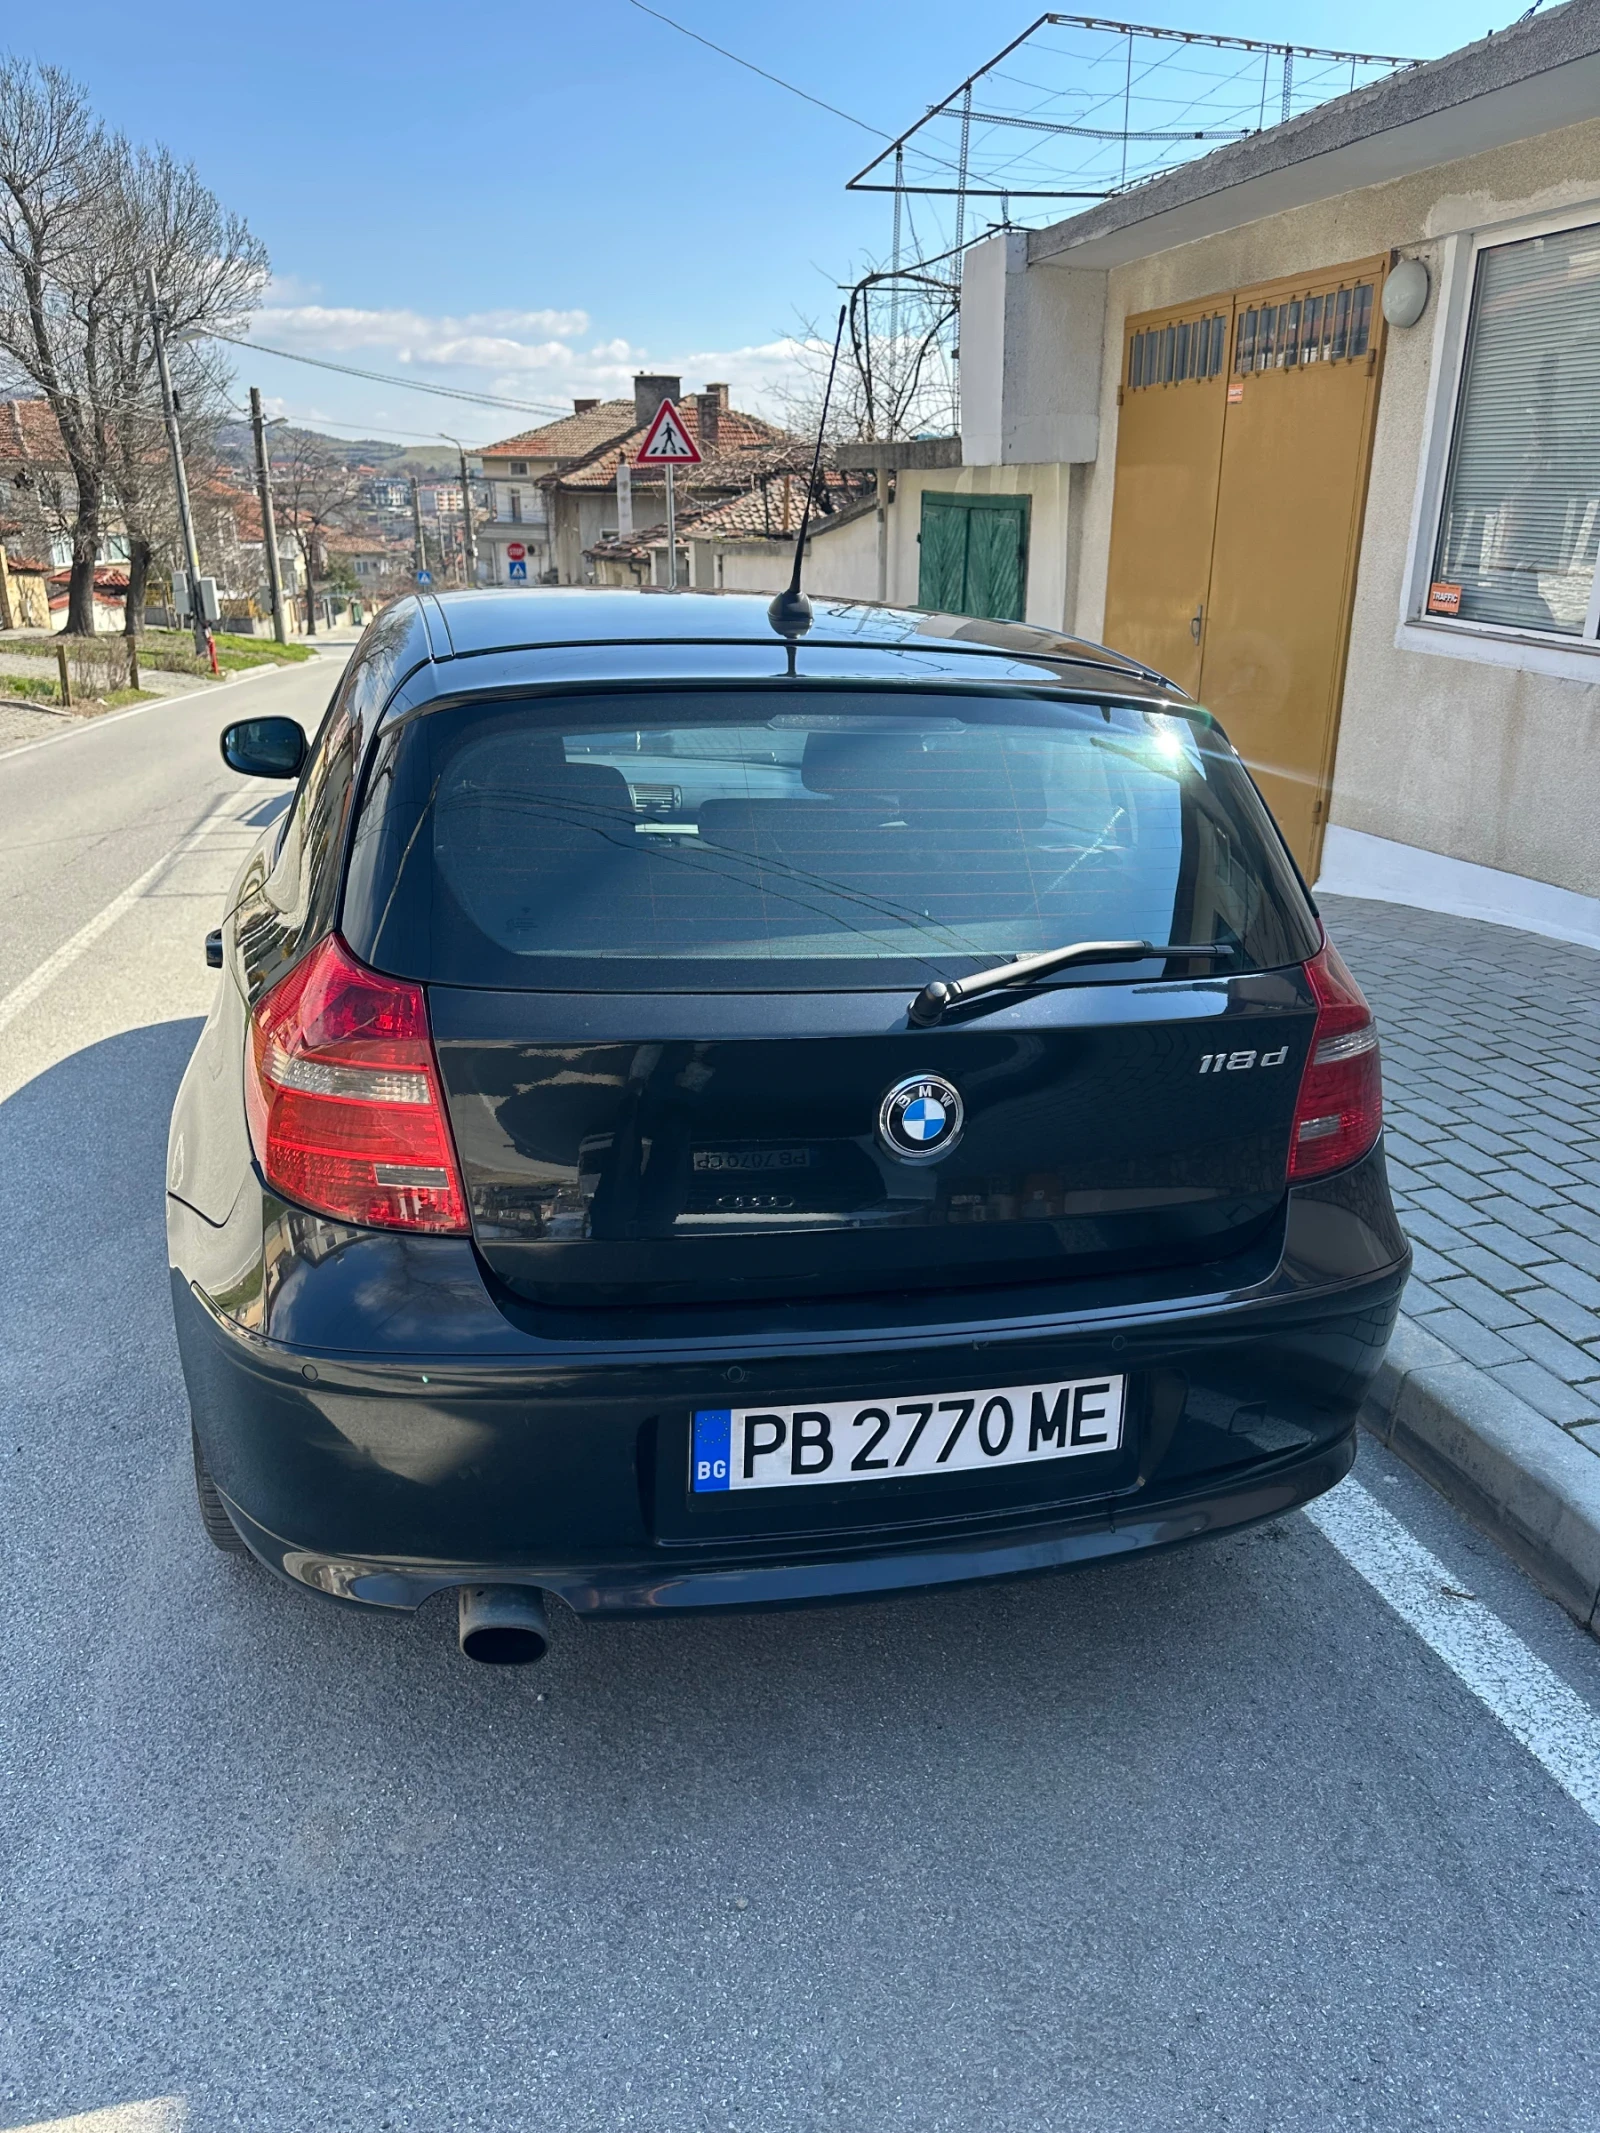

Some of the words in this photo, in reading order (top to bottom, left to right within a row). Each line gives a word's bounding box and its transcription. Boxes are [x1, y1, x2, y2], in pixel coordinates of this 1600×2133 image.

[509, 547, 524, 555] STOP
[1432, 591, 1458, 603] TRAFFIC
[896, 1085, 954, 1109] BMW
[697, 1154, 723, 1169] CP
[727, 1152, 775, 1169] 7070
[779, 1151, 806, 1167] PB
[742, 1411, 834, 1479] PB
[850, 1395, 1014, 1472] 2770
[1028, 1383, 1110, 1452] ME
[697, 1460, 727, 1480] BG
